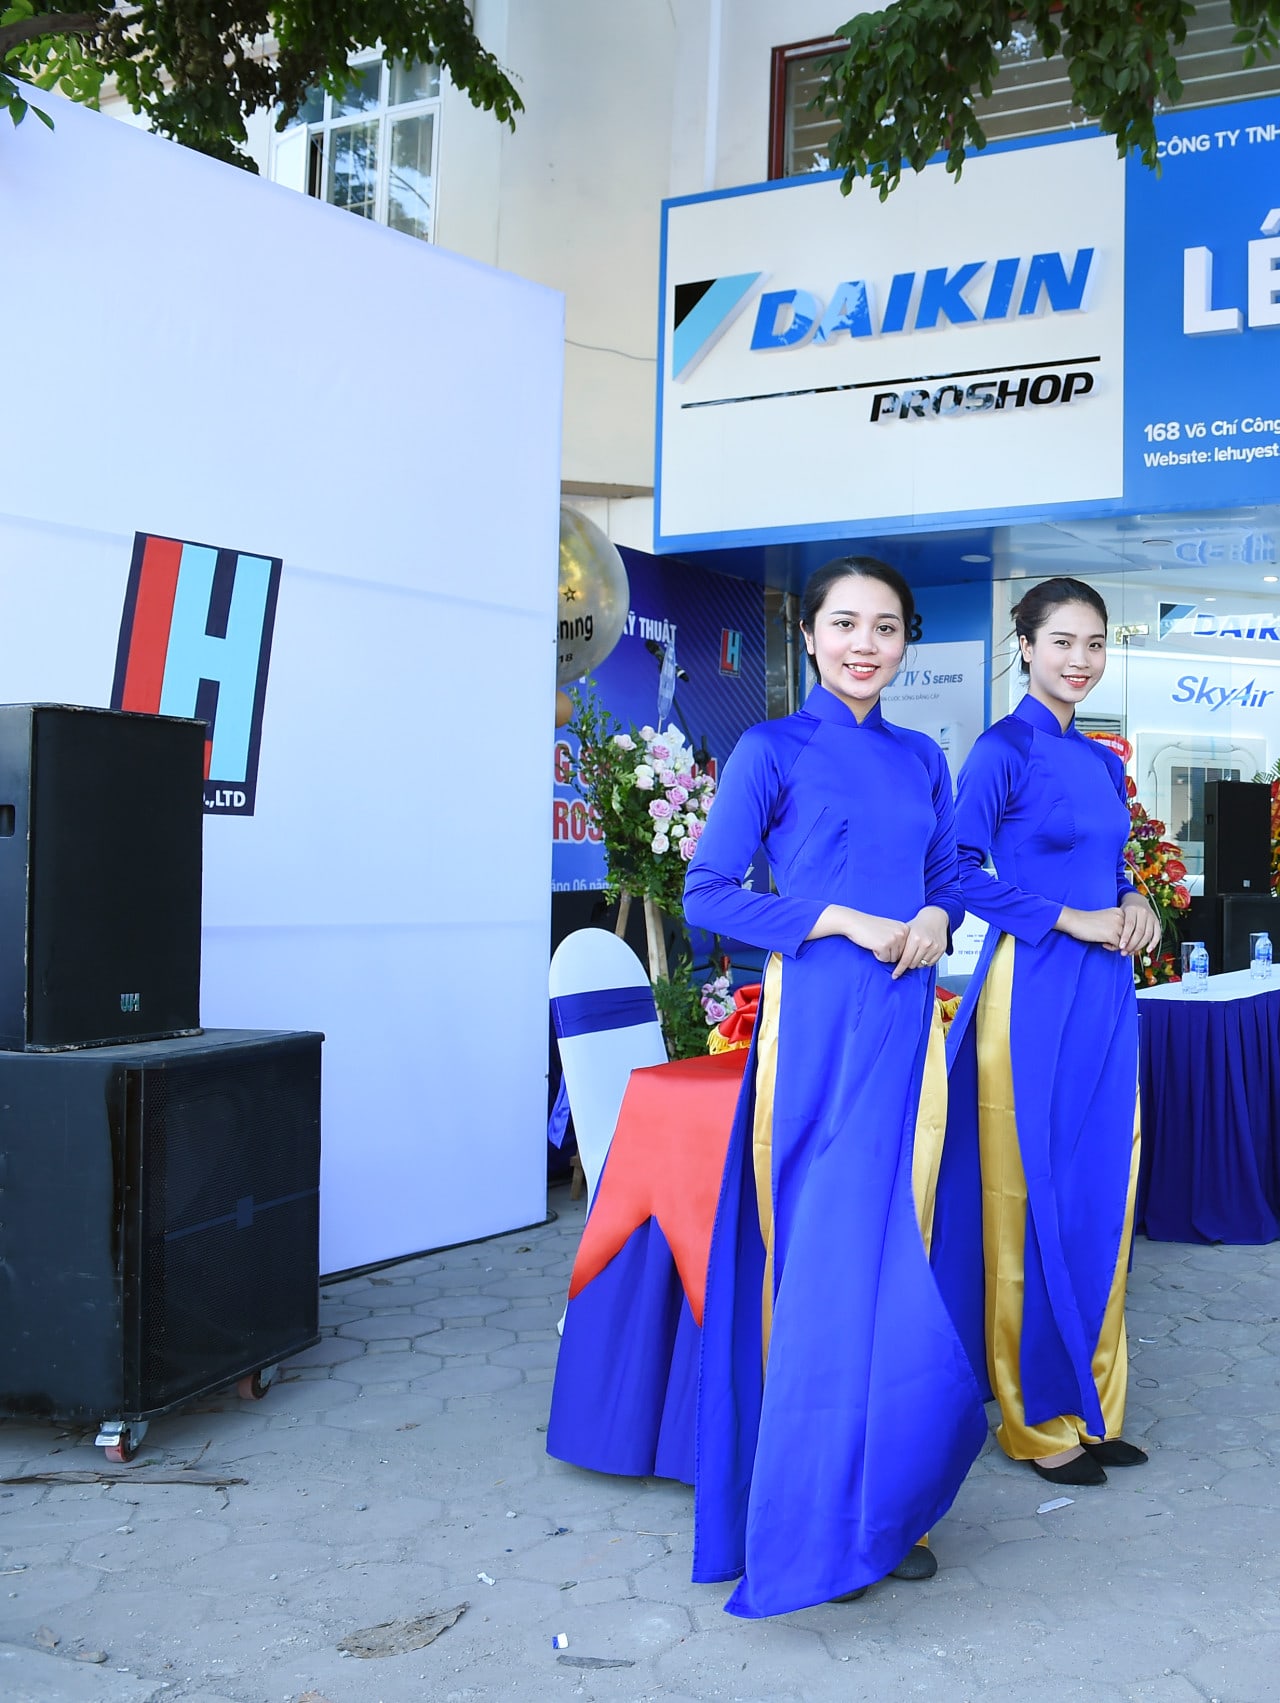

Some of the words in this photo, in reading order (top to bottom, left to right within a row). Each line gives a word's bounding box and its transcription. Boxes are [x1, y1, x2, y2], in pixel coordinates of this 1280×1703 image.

[1156, 134, 1211, 158] CÔNG
[1214, 129, 1241, 149] TY
[750, 246, 1095, 351] DAIKIN
[869, 371, 1095, 423] PROSHOP
[1143, 422, 1181, 442] 168
[1185, 422, 1207, 438] Võ
[1210, 418, 1238, 436] Chí
[1143, 450, 1213, 468] Website:
[557, 614, 593, 642] ning
[933, 674, 964, 684] SERIES
[1171, 676, 1275, 712] SkyAir
[203, 789, 247, 809] .,LTD
